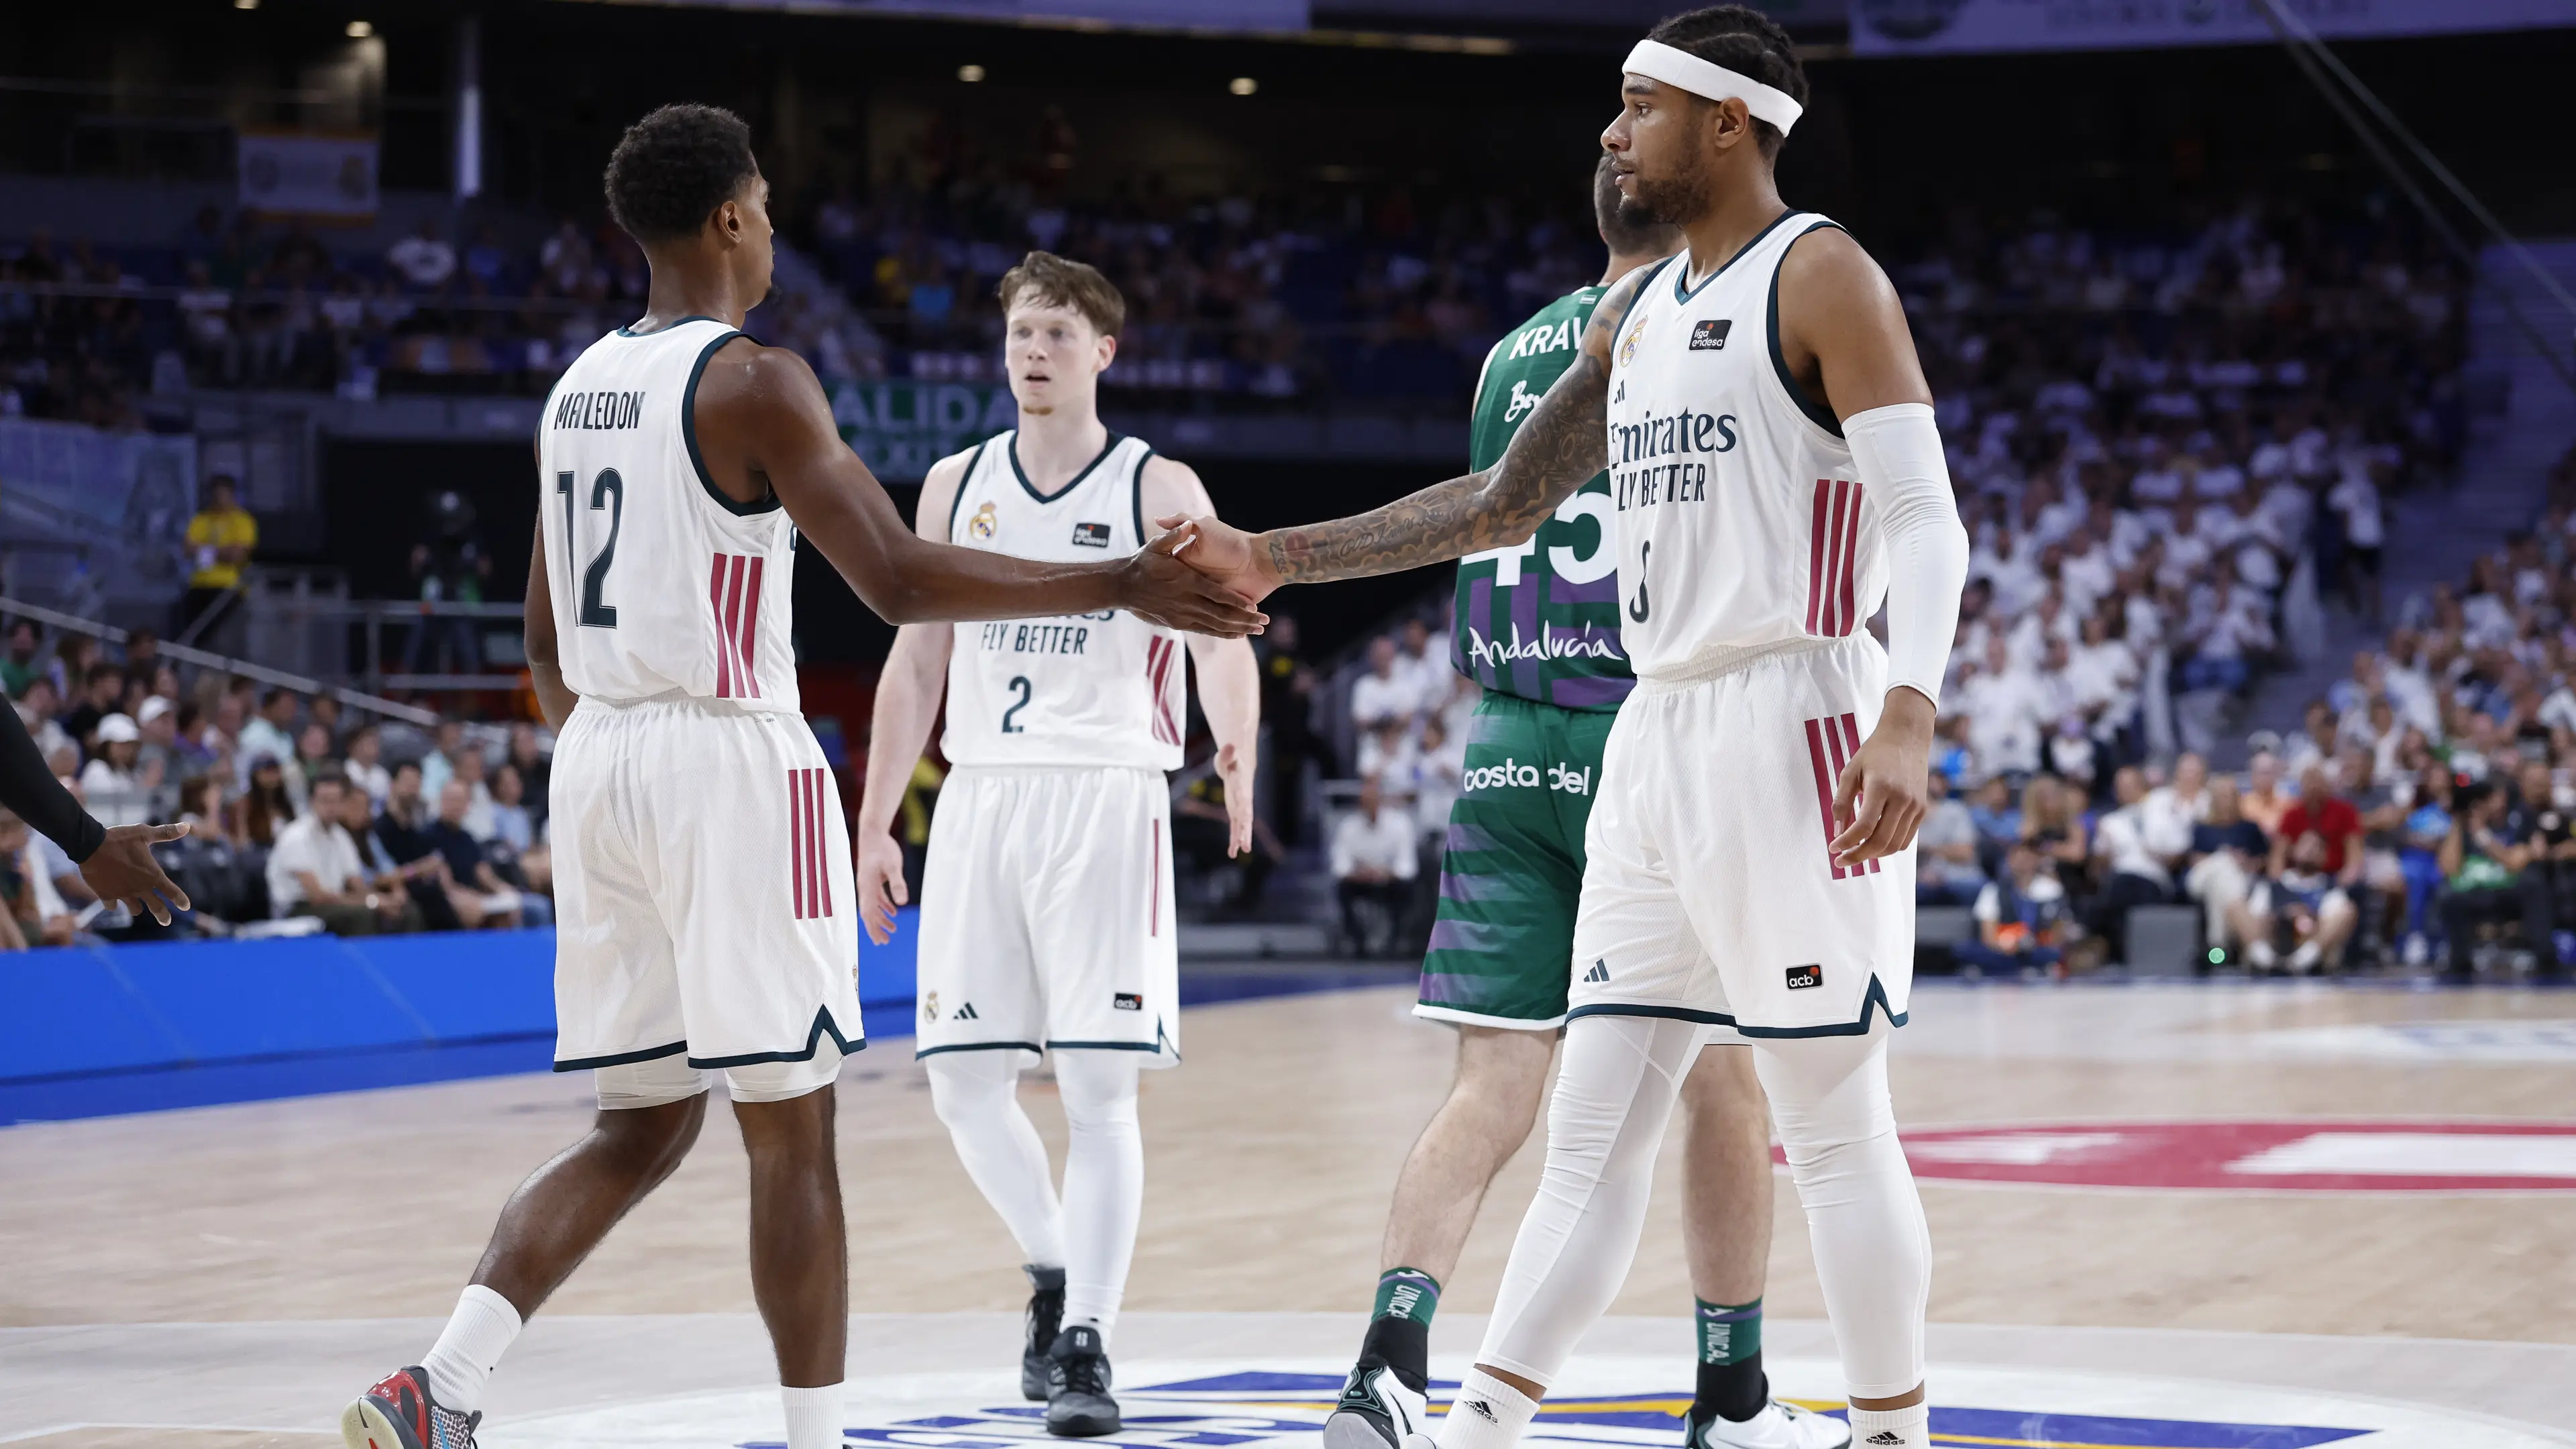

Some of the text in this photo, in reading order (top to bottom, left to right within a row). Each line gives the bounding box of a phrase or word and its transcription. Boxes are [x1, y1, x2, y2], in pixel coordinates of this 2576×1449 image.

[1692, 337, 1723, 347] endesa
[1694, 328, 1709, 339] liga
[554, 391, 645, 430] MALEDON
[832, 384, 1018, 433] ALIDA
[1616, 472, 1637, 512] LY
[557, 468, 623, 629] 12
[981, 623, 1088, 655] FLY BETTER
[1468, 619, 1624, 668] Andalucía
[1002, 676, 1032, 733] 2
[1464, 757, 1591, 796] costa del
[1789, 974, 1814, 987] acb
